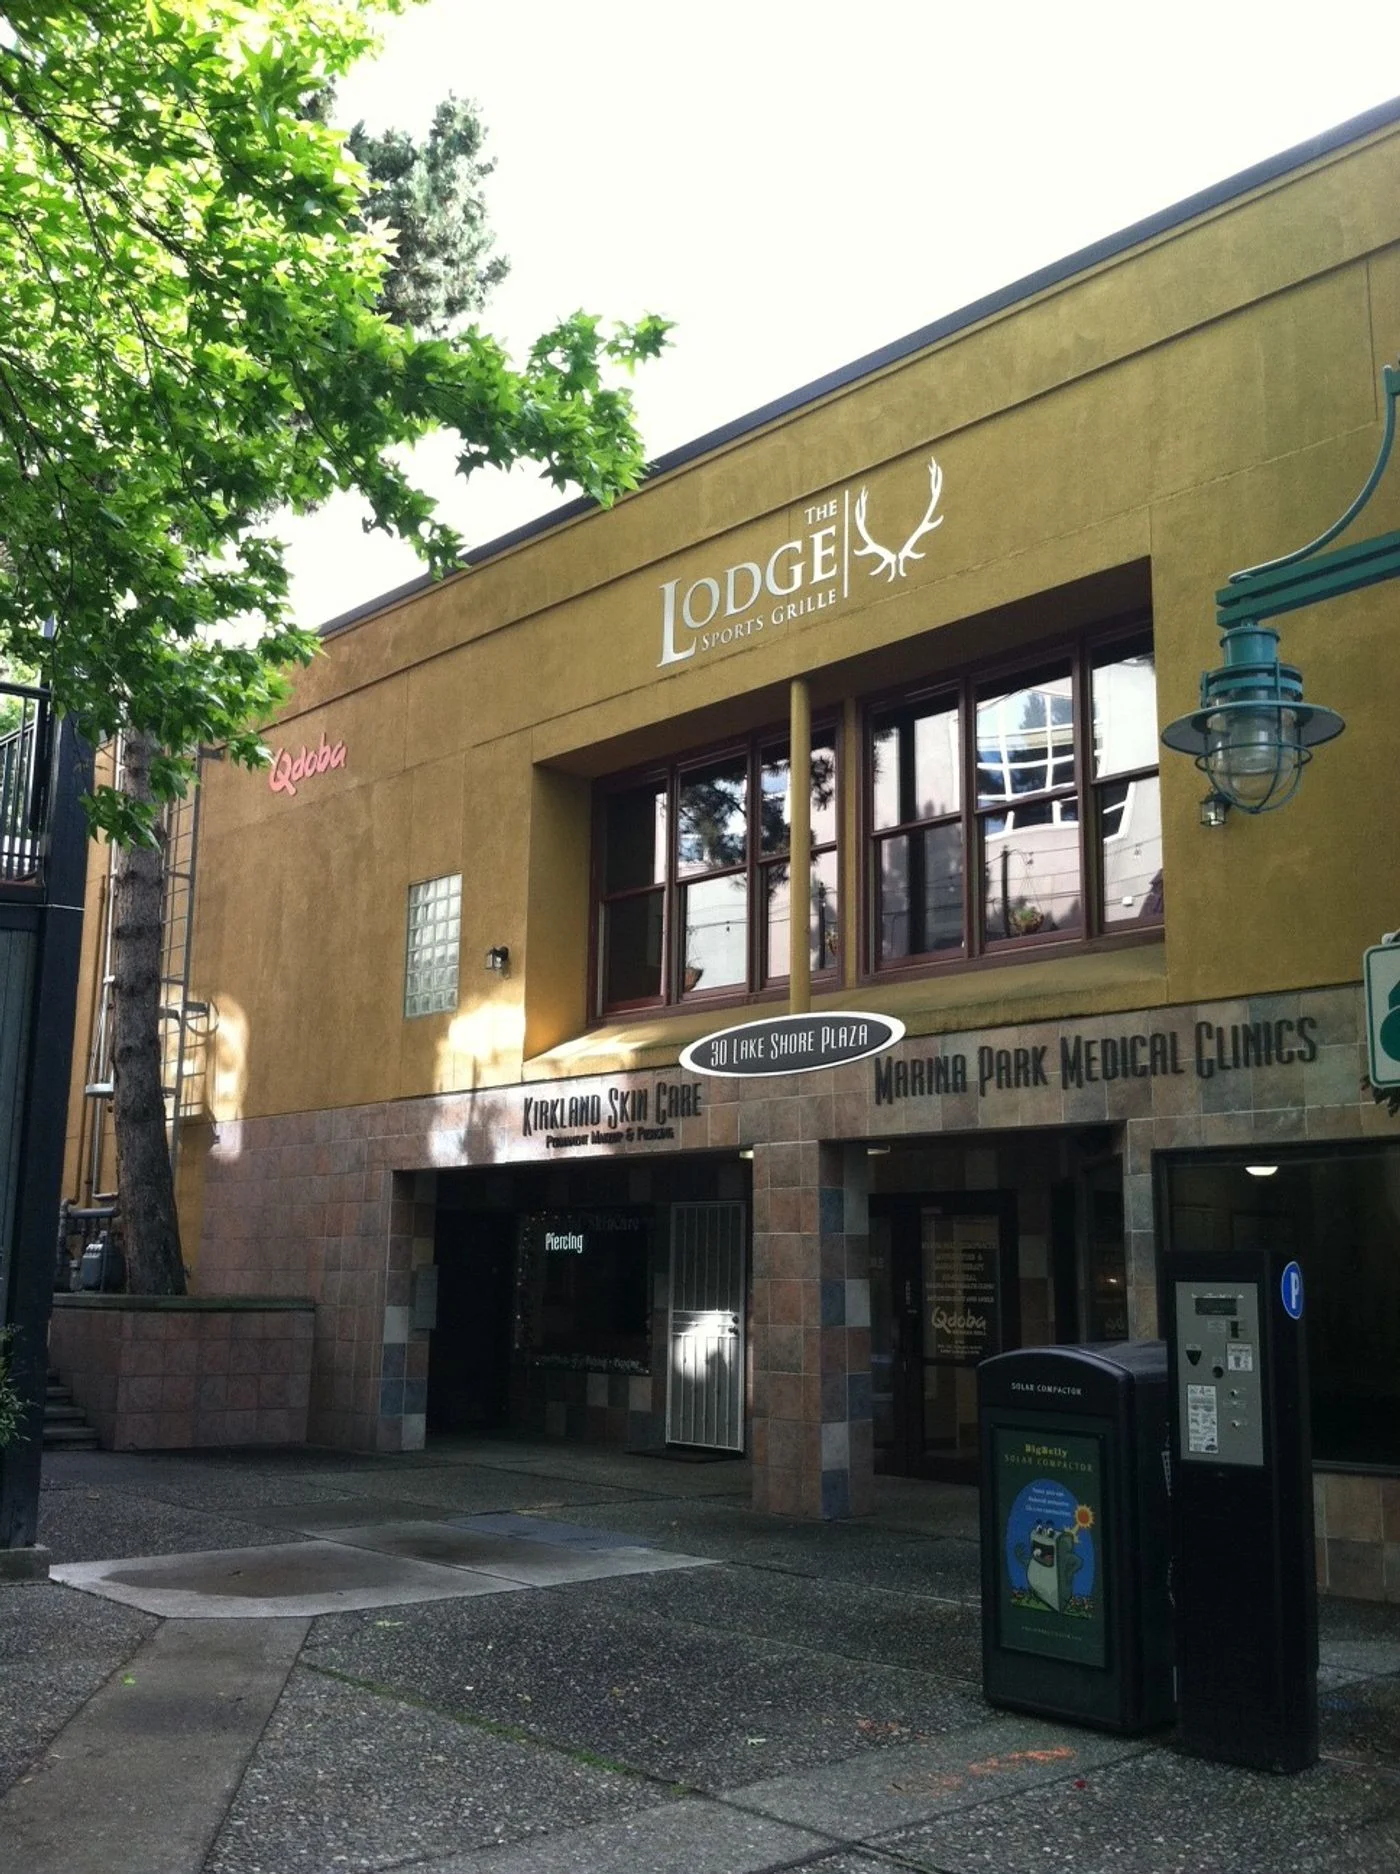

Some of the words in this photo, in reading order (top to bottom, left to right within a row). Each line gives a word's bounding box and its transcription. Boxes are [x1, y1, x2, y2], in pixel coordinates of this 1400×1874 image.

[804, 500, 838, 525] THE
[656, 525, 838, 668] LODGE
[701, 617, 764, 650] SPORTS
[771, 589, 837, 626] GRILLE
[269, 732, 347, 796] Qdoba
[710, 1039, 728, 1067] 30
[732, 1037, 765, 1064] LAKE
[770, 1030, 815, 1060] SHORE
[821, 1024, 869, 1053] PLAZA
[874, 1053, 968, 1106] MARINA
[977, 1045, 1048, 1098] PARK
[1060, 1032, 1185, 1090] MEDICAL
[1195, 1016, 1318, 1080] CLINICS
[522, 1094, 601, 1137] KIRKLAND
[607, 1087, 648, 1130] SKIN
[655, 1081, 703, 1126] CARE
[545, 1231, 584, 1255] Piercing
[1289, 1271, 1300, 1310] P
[932, 1306, 986, 1334] Qdoba
[1011, 1382, 1035, 1392] SOLAR
[1037, 1384, 1082, 1396] COMPACTOR
[1003, 1454, 1033, 1465] SOLAR
[1036, 1458, 1093, 1473] COMPACTOR
